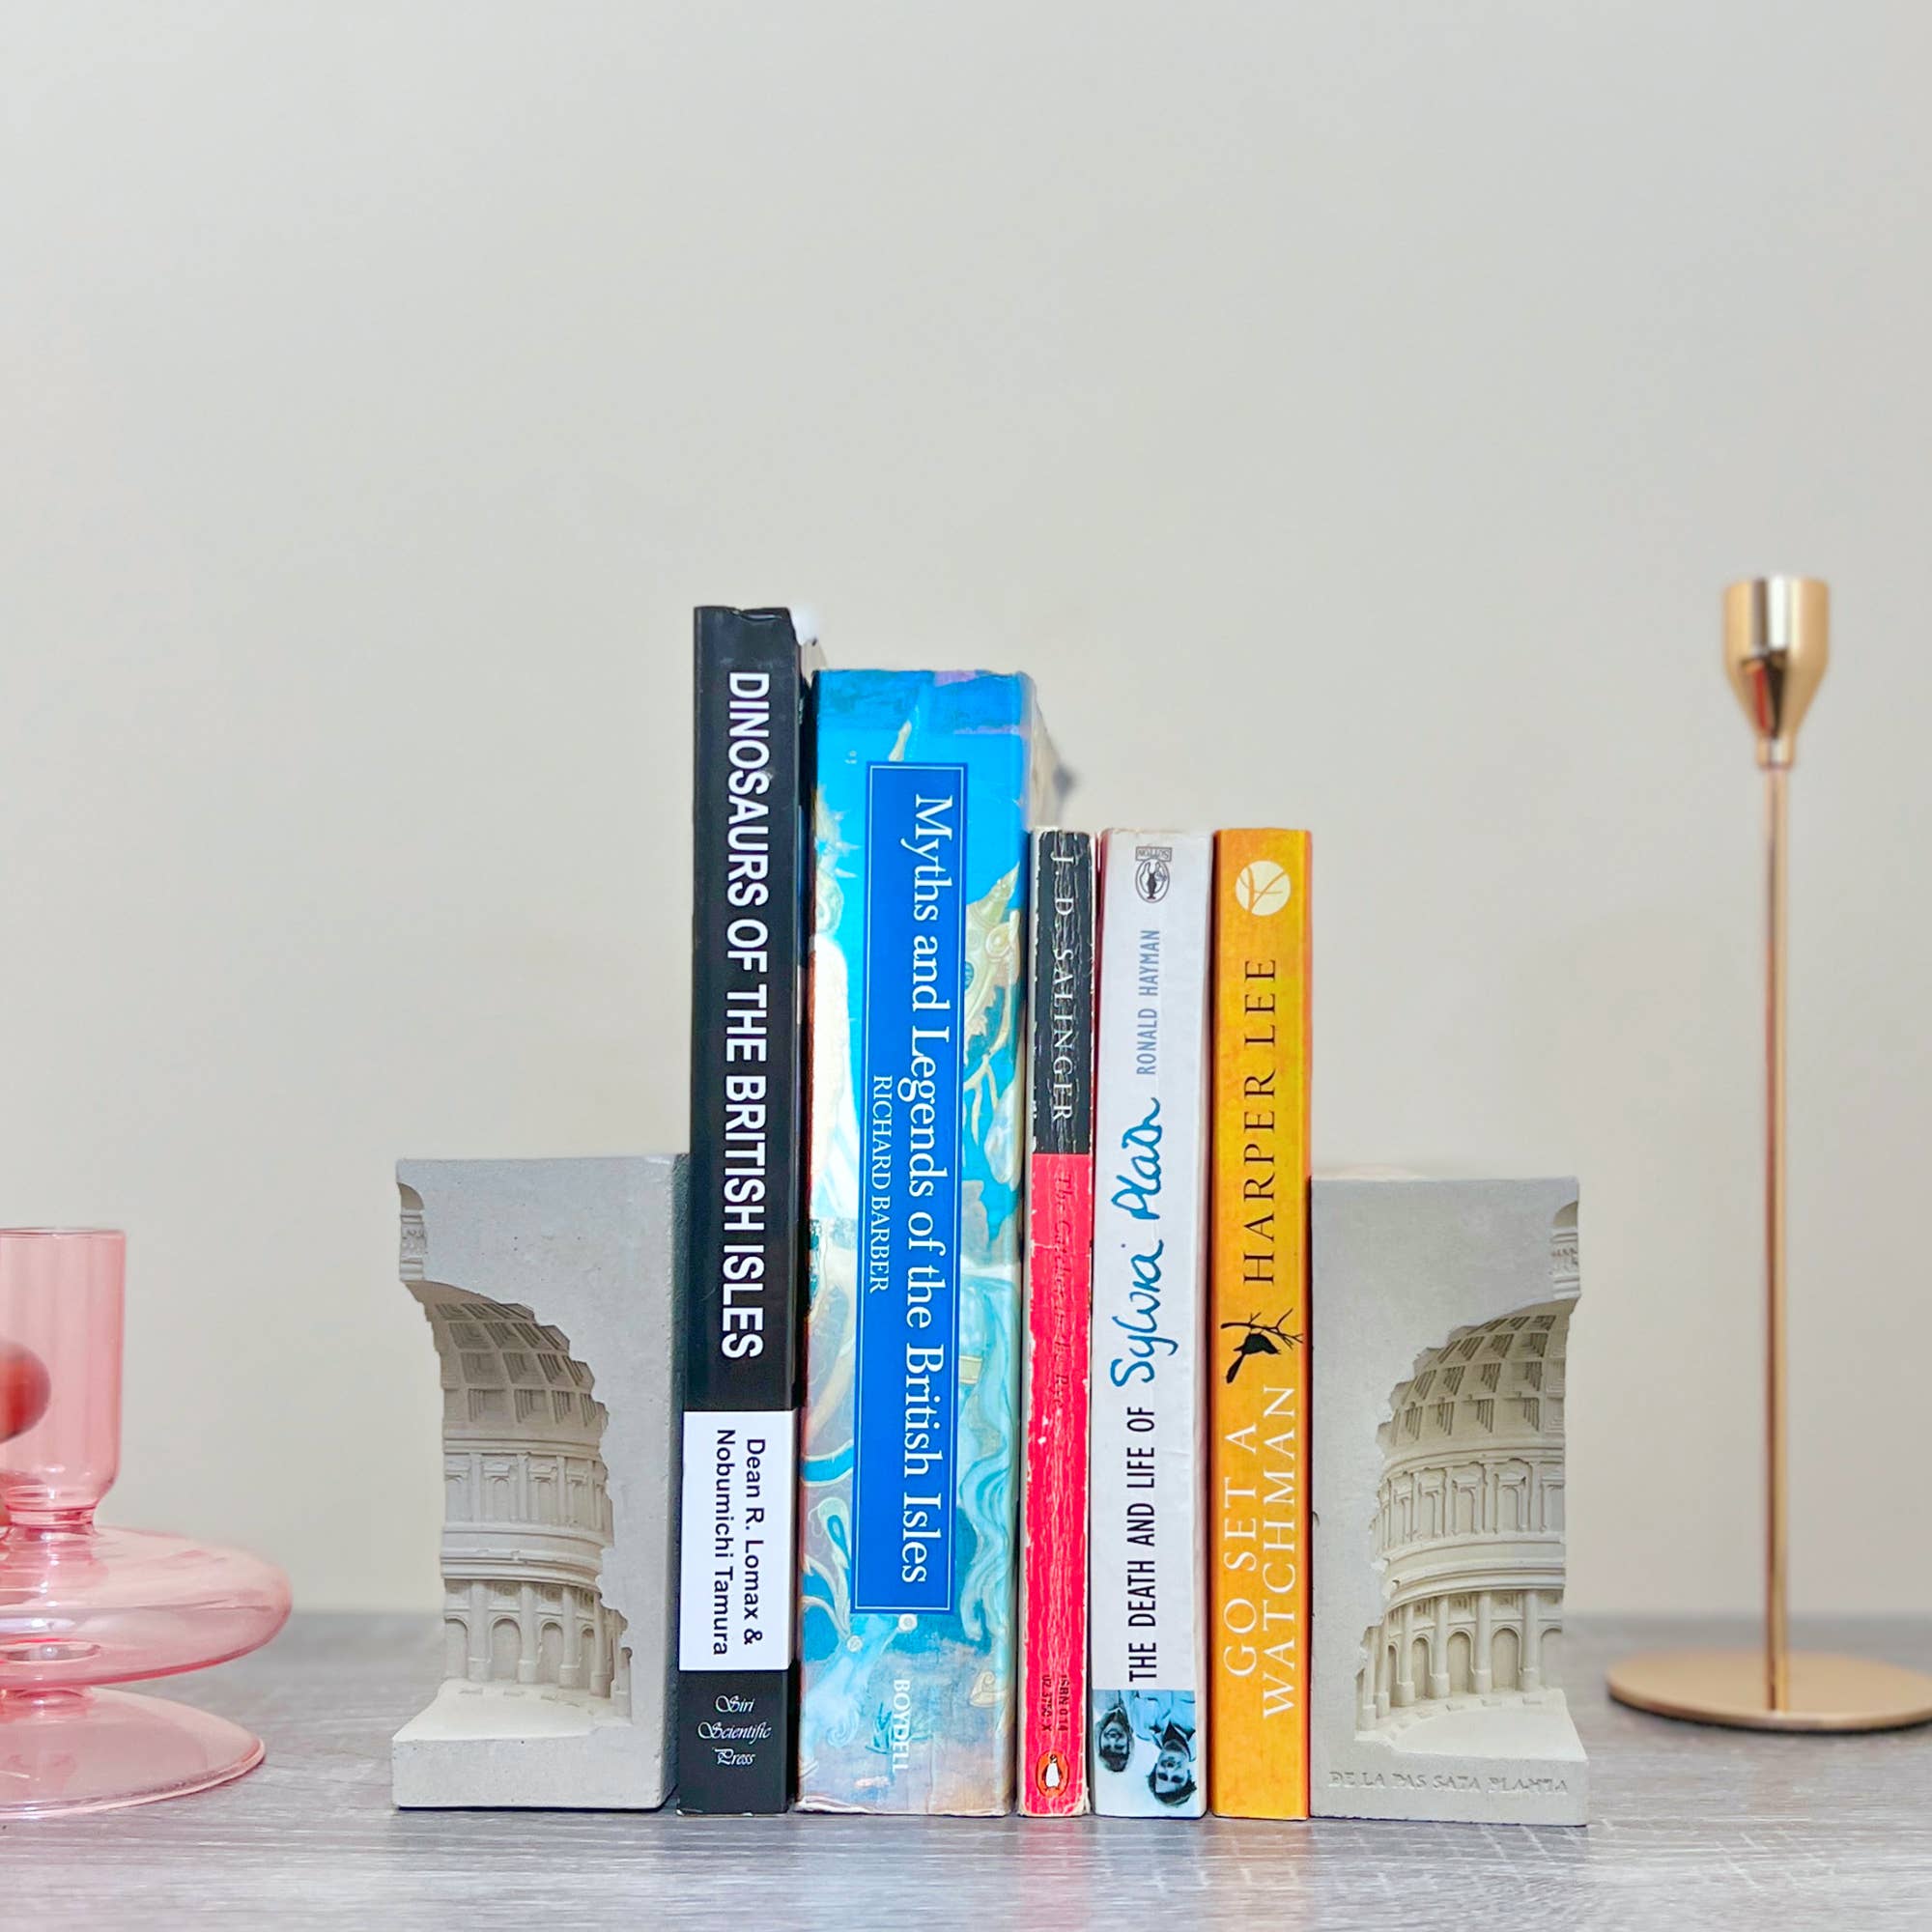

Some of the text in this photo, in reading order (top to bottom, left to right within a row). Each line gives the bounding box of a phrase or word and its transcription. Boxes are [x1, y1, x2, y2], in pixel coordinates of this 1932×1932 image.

[722, 672, 771, 1358] DINOSAURS OF THE BRITISH ISLES
[1050, 949, 1075, 1122] SALINGER
[1136, 929, 1160, 1075] RONALD HAYMAN
[869, 1075, 893, 1293] RICHARD BARBER
[896, 794, 953, 1582] Myths and Legends of the British Isles
[1243, 959, 1276, 1284] HARPER LEE
[1110, 1096, 1179, 1683] THE DEATH AND LIFE OF Sylvia Plath
[713, 1429, 736, 1655] Nobumichi Tamura
[743, 1438, 766, 1645] Dean R. Lomax &
[1223, 1424, 1258, 1677] GO SET A
[1263, 1386, 1295, 1719] WATCHMAN
[697, 1721, 772, 1745] Scientific
[712, 1747, 756, 1766] Press
[715, 1695, 754, 1713] Siri
[892, 1678, 912, 1774] BOYDELL
